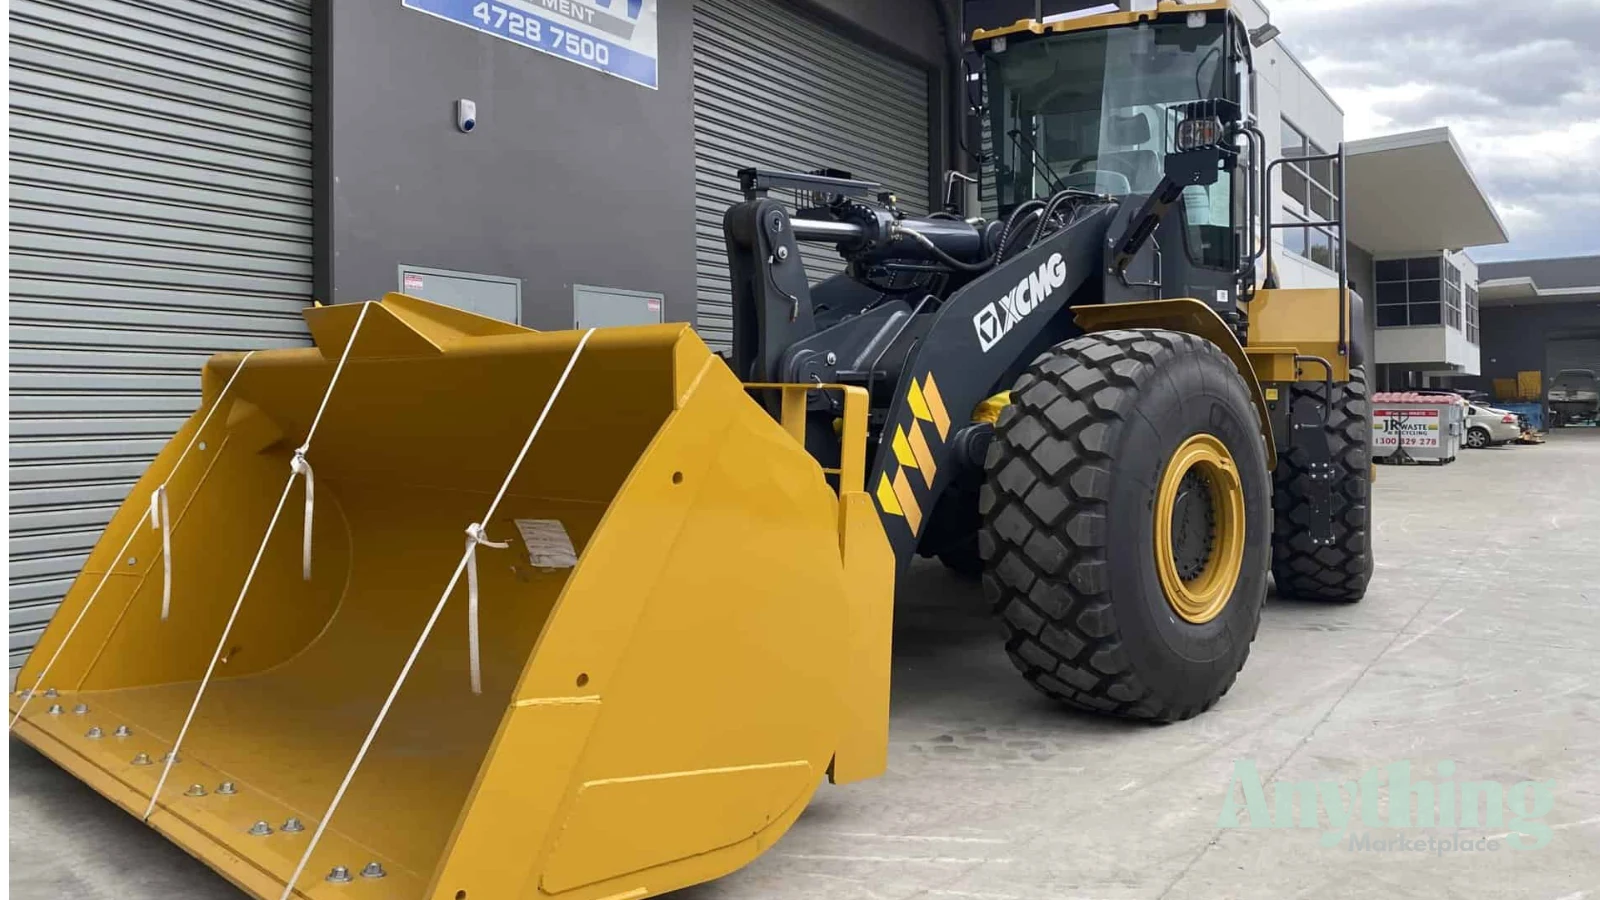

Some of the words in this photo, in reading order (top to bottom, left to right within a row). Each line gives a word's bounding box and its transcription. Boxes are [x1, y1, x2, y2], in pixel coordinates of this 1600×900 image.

[473, 1, 541, 42] 4728
[549, 25, 609, 66] 7500
[998, 252, 1067, 335] XCMG
[1383, 419, 1399, 433] JR
